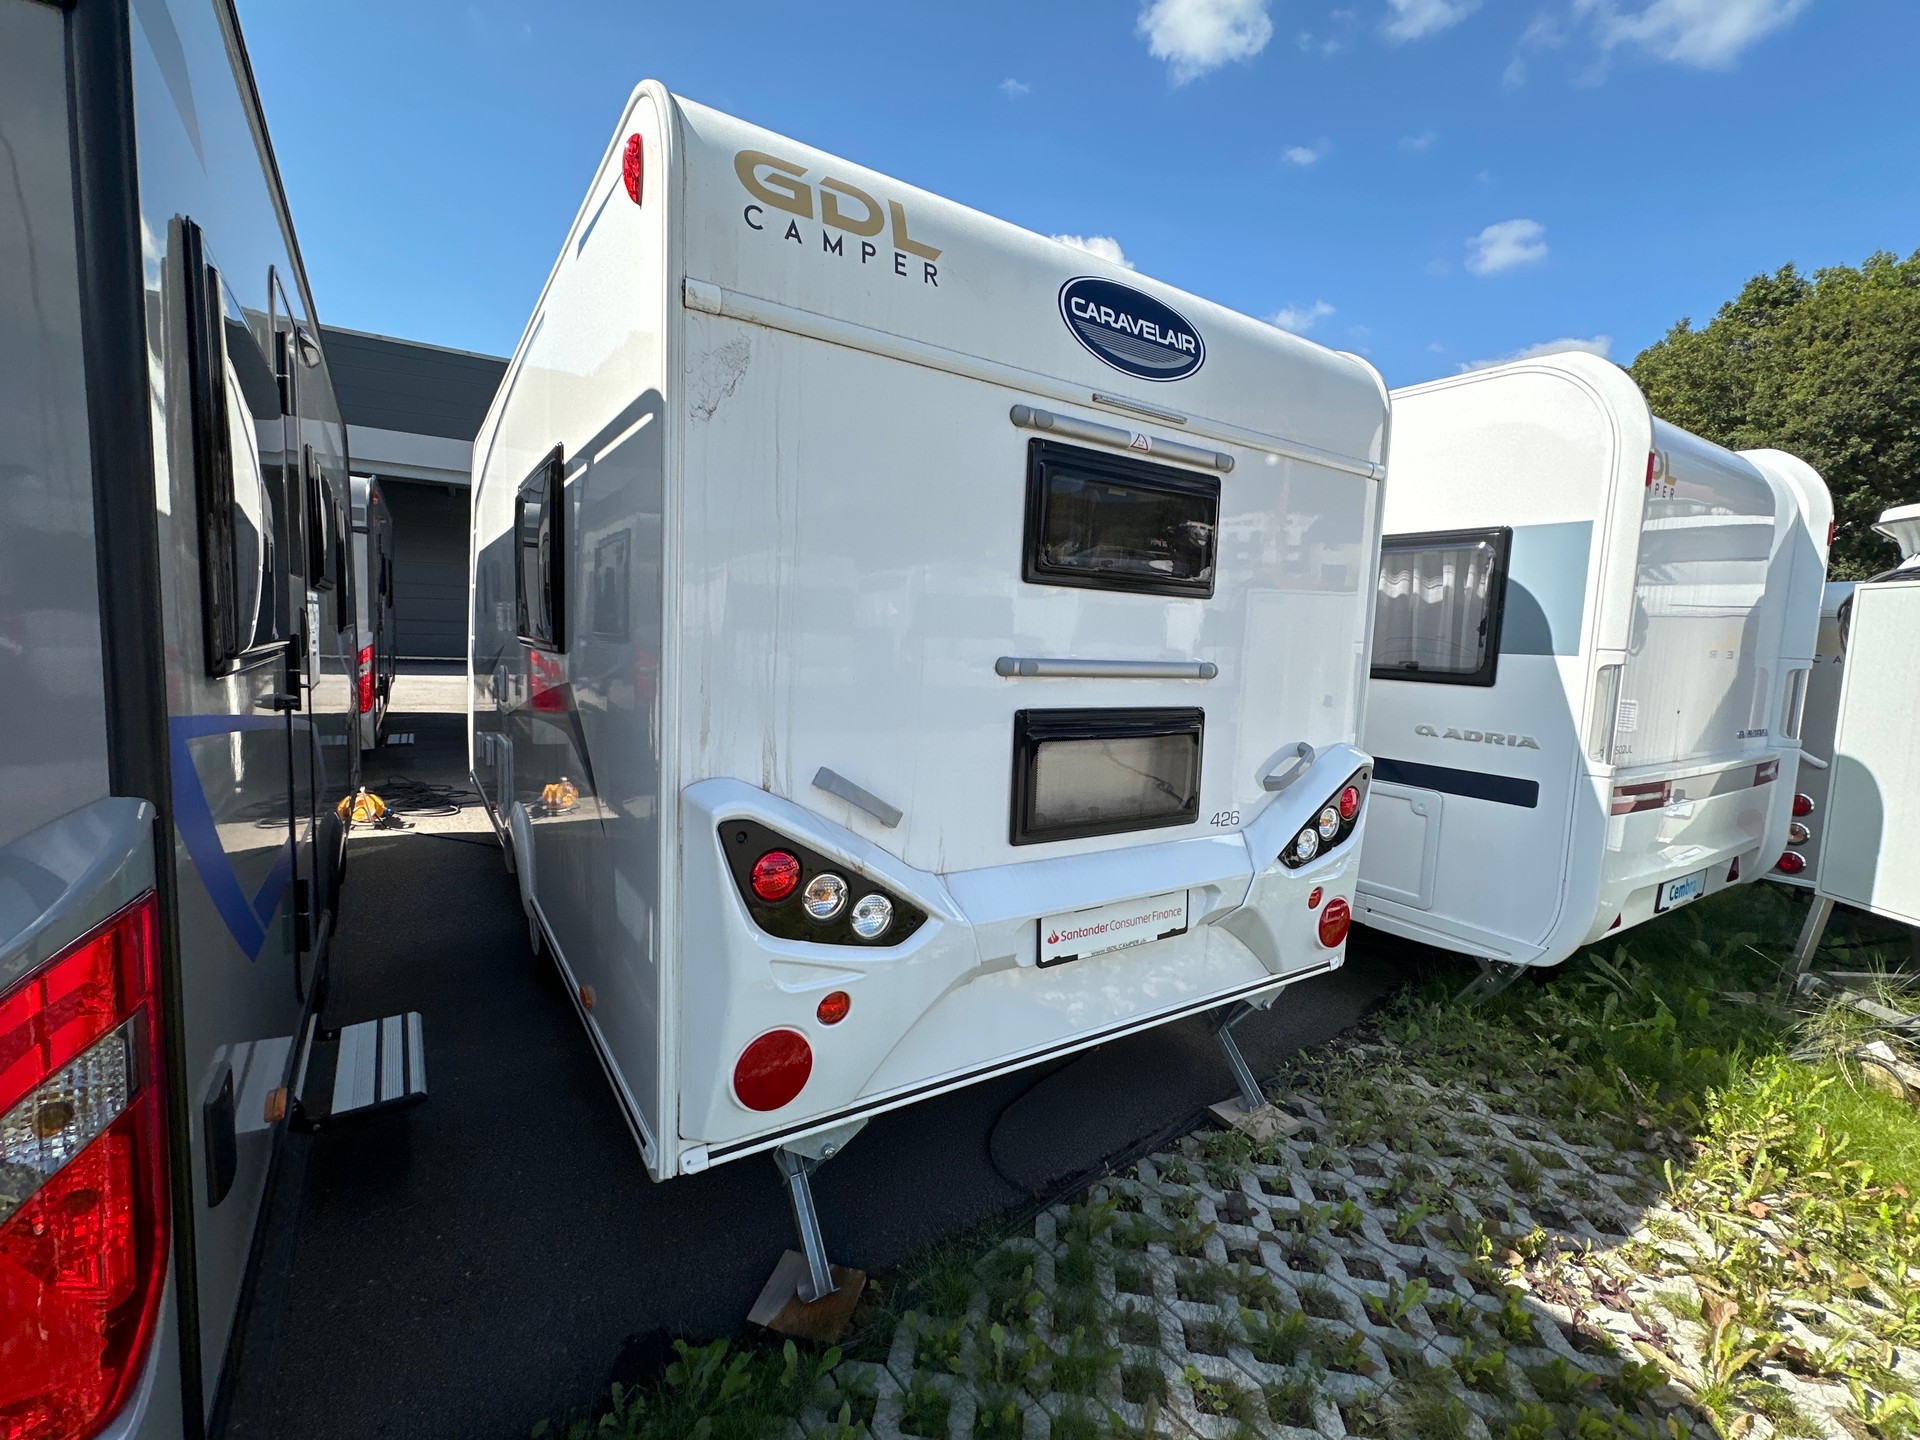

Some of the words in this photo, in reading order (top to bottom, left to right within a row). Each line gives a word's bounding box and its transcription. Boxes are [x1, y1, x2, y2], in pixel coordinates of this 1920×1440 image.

[734, 150, 942, 261] GDL
[743, 204, 939, 287] CAMPER
[1071, 296, 1196, 355] CARAVELAIR
[1652, 448, 1677, 486] DL
[1649, 484, 1675, 501] PER
[1442, 728, 1541, 750] ADRIA
[1210, 811, 1240, 827] 426
[1669, 878, 1697, 902] Cembra
[1060, 923, 1109, 942] Santander
[1109, 914, 1152, 931] Consumer
[1152, 907, 1182, 922] Finance
